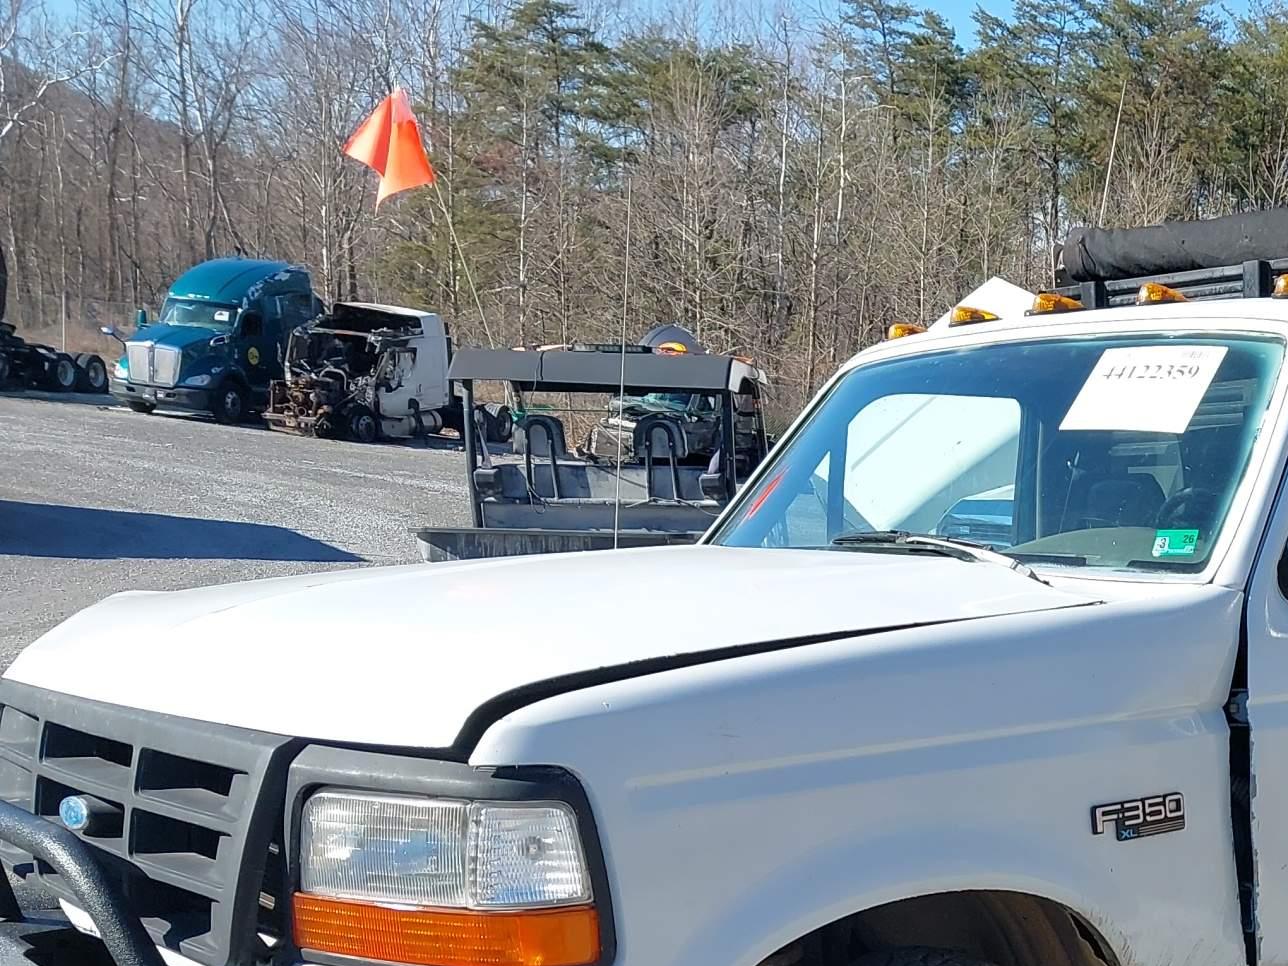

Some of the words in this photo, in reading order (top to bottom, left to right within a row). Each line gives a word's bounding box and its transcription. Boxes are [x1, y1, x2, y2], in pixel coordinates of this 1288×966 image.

[1102, 365, 1200, 380] 44122359
[1183, 534, 1195, 544] 26
[1120, 829, 1138, 839] XL
